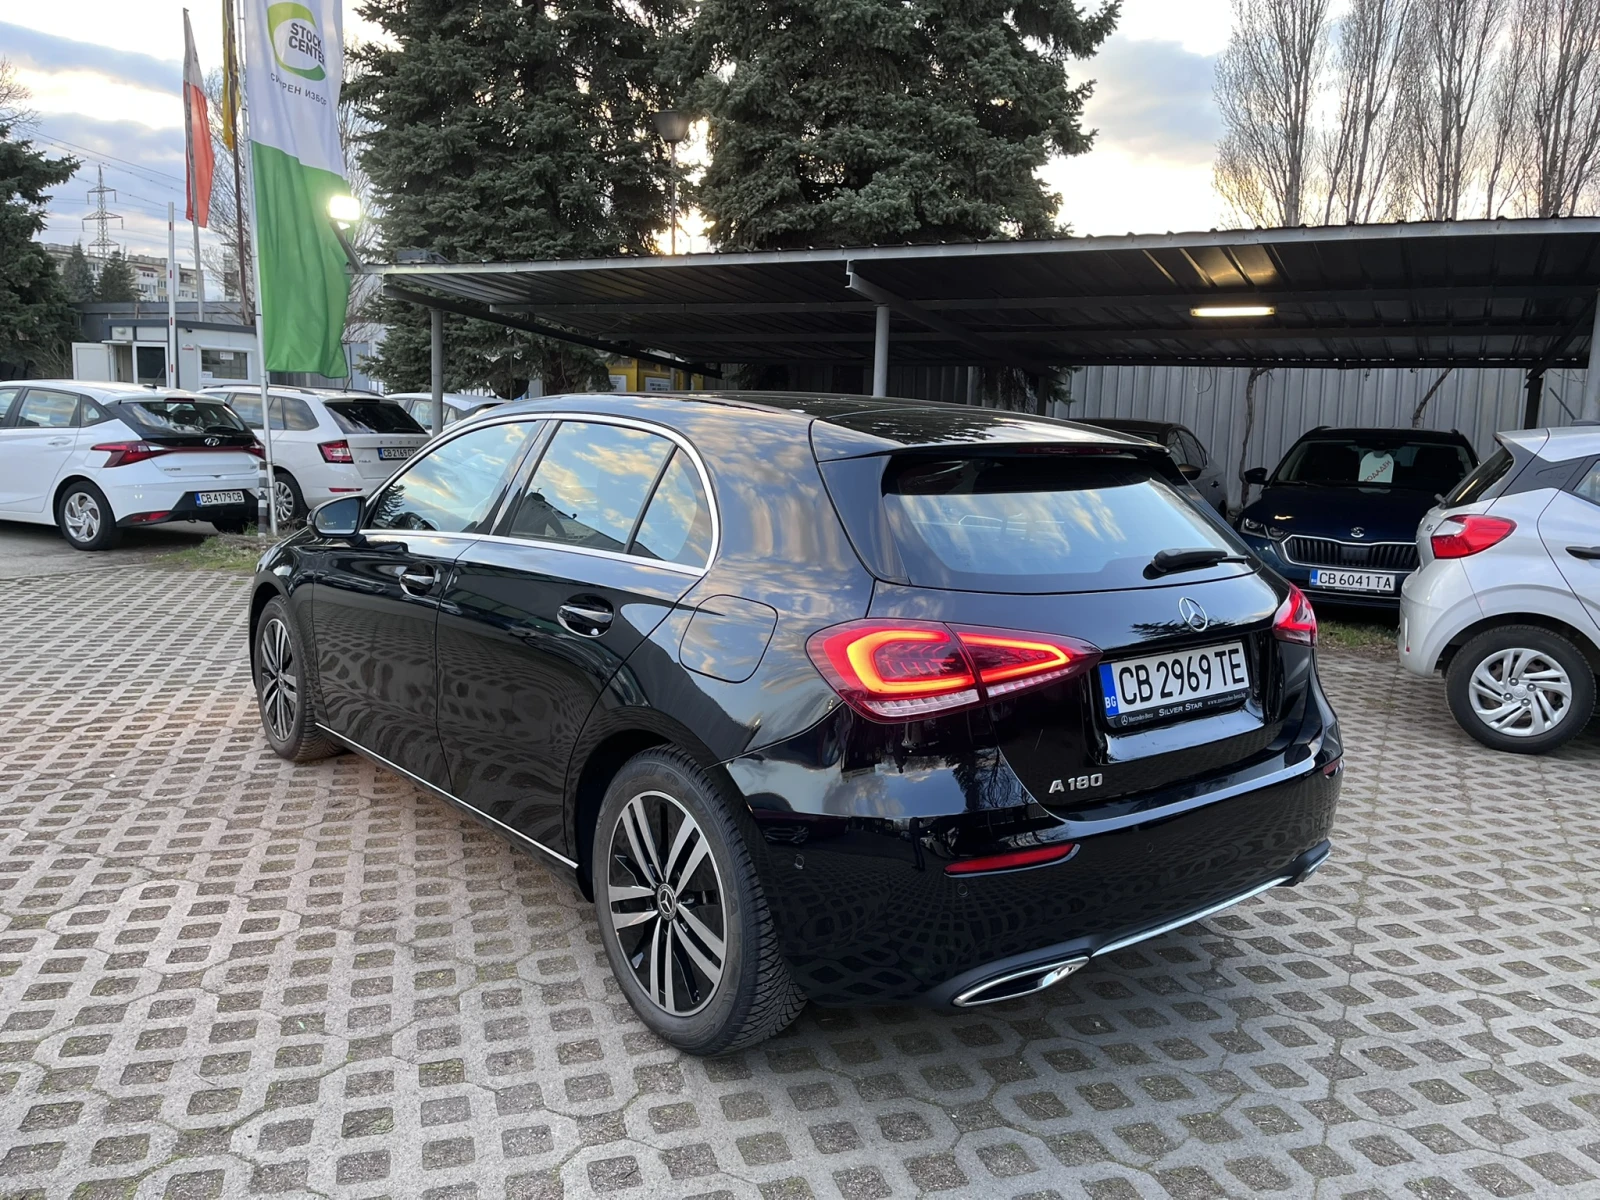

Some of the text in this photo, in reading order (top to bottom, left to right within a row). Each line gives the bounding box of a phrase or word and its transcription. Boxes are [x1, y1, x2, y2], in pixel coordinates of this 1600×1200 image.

[289, 35, 325, 65] CENTE
[200, 491, 243, 504] CB 4179 CB
[1319, 572, 1337, 585] CB
[1338, 573, 1370, 587] 6041
[1374, 576, 1392, 589] TA
[1118, 648, 1245, 705] CB 2969 TE
[1104, 695, 1117, 709] BG
[1158, 705, 1184, 717] SILVER
[1185, 701, 1204, 712] STAR
[1048, 772, 1103, 794] A 180
